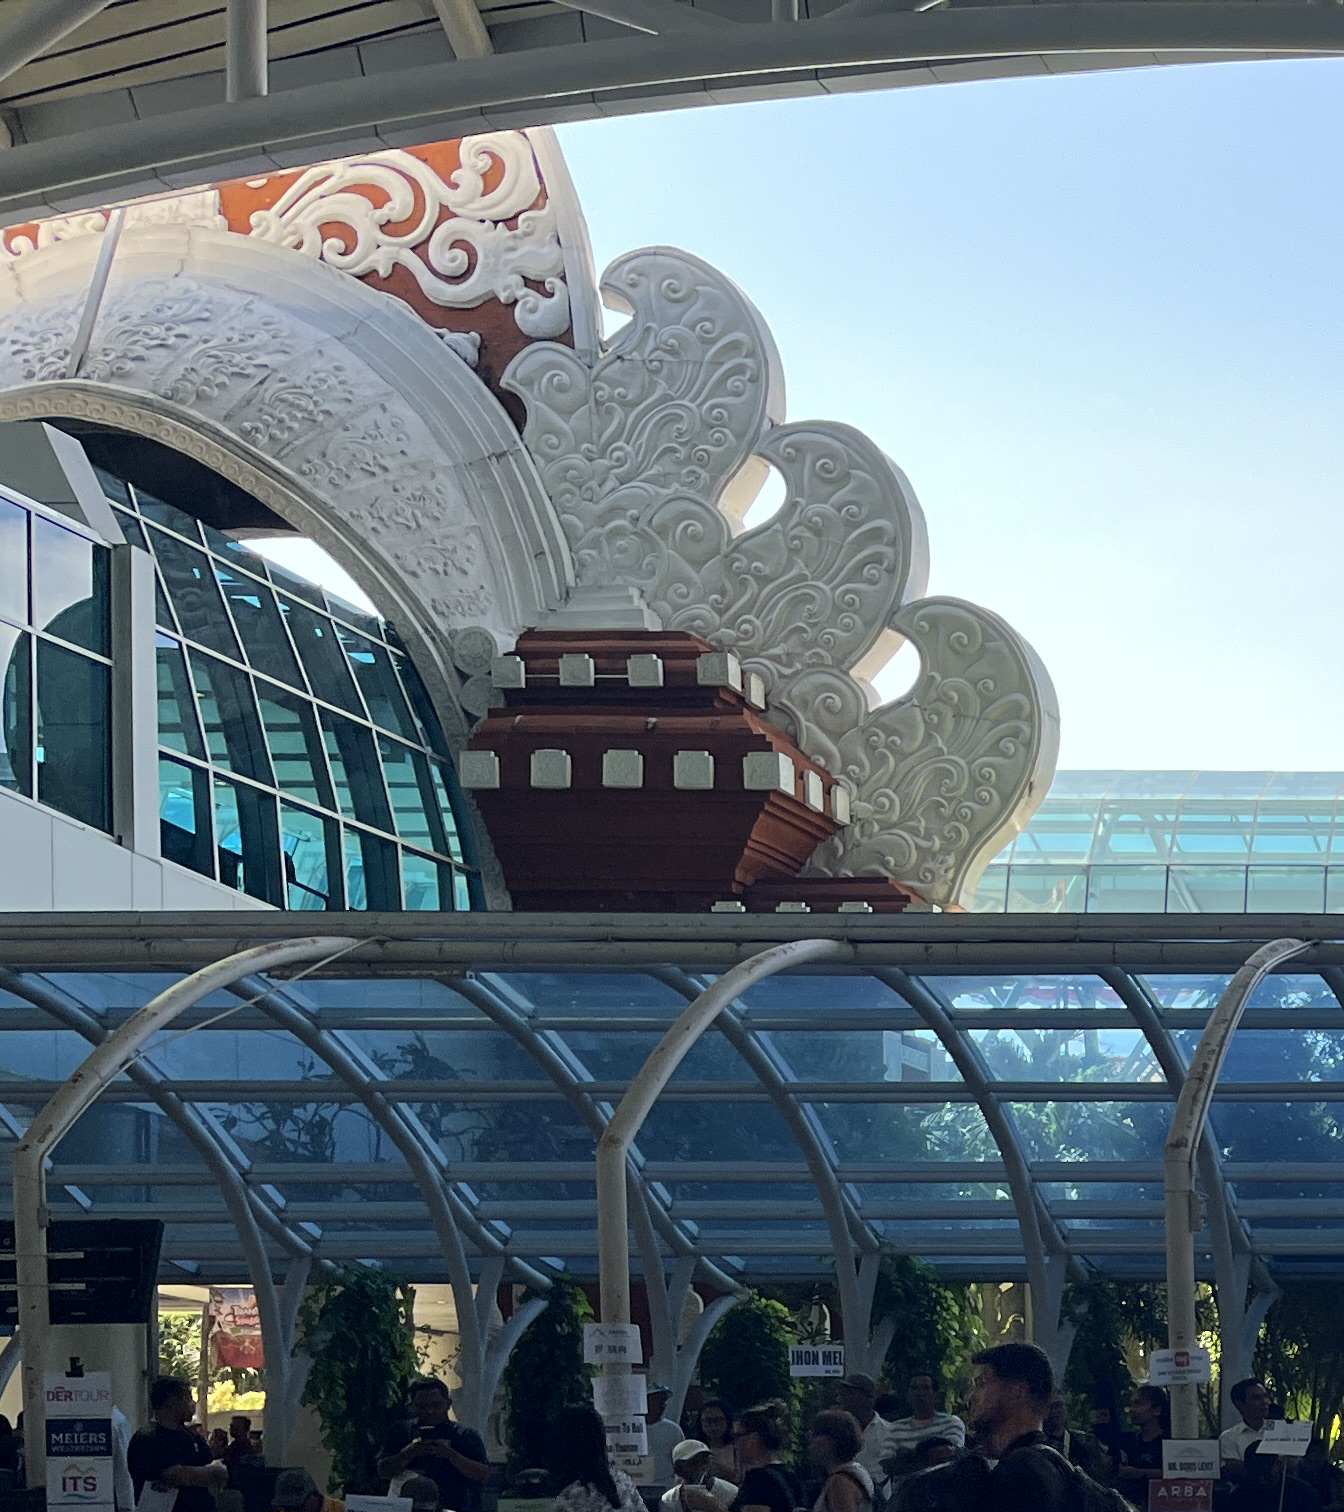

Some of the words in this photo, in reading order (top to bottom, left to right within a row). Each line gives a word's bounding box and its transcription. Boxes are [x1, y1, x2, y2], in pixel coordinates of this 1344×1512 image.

[50, 1432, 107, 1445] MEIERS
[62, 1476, 97, 1492] ITS
[1157, 1485, 1208, 1498] ARBA
